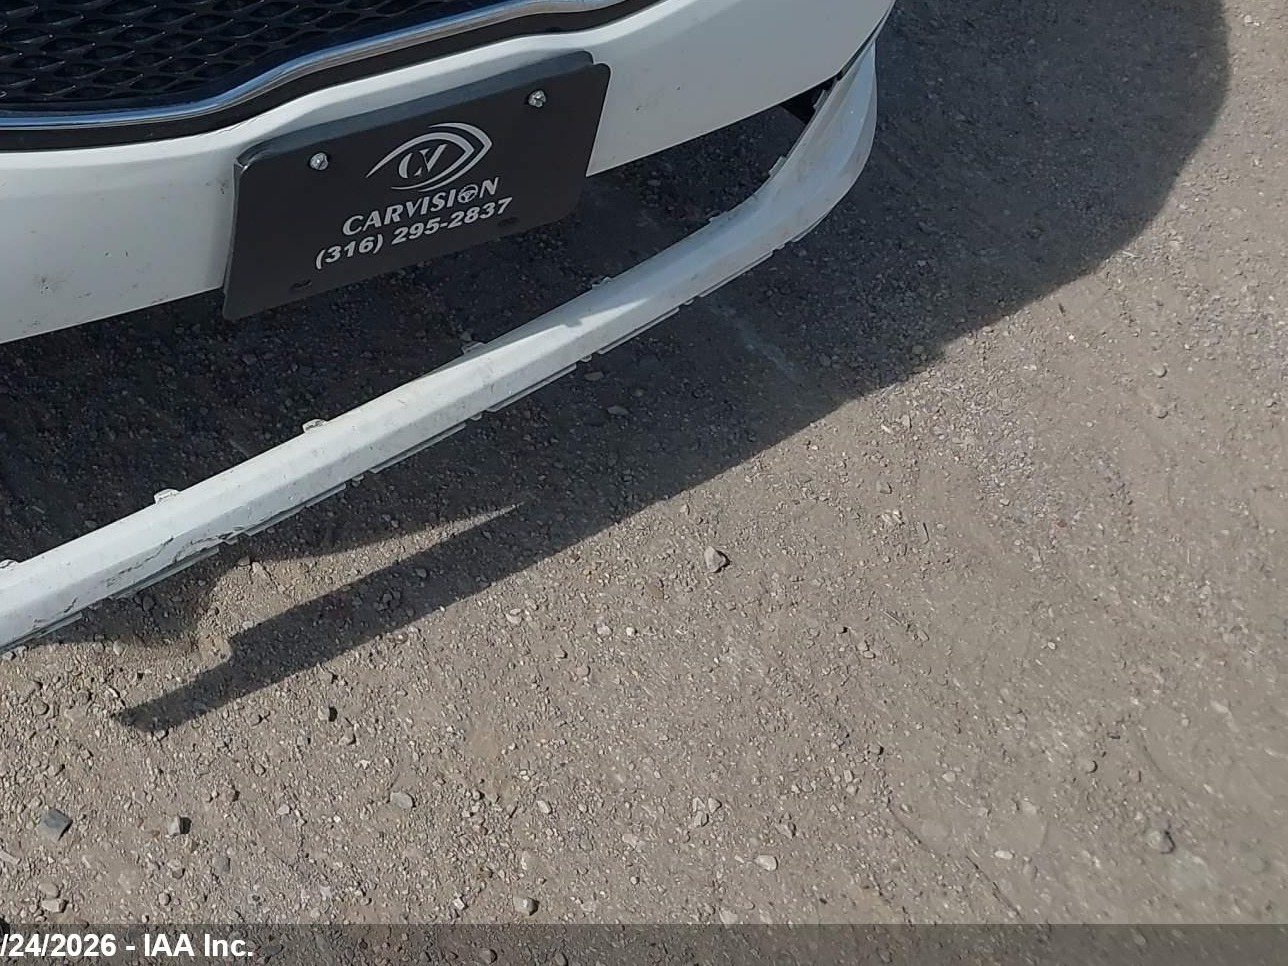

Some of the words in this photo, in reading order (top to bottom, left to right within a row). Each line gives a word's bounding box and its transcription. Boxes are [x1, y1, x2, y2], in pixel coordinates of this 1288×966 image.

[315, 234, 384, 269] (316)
[391, 197, 513, 245] 295-2837
[342, 177, 500, 236] CARVISION
